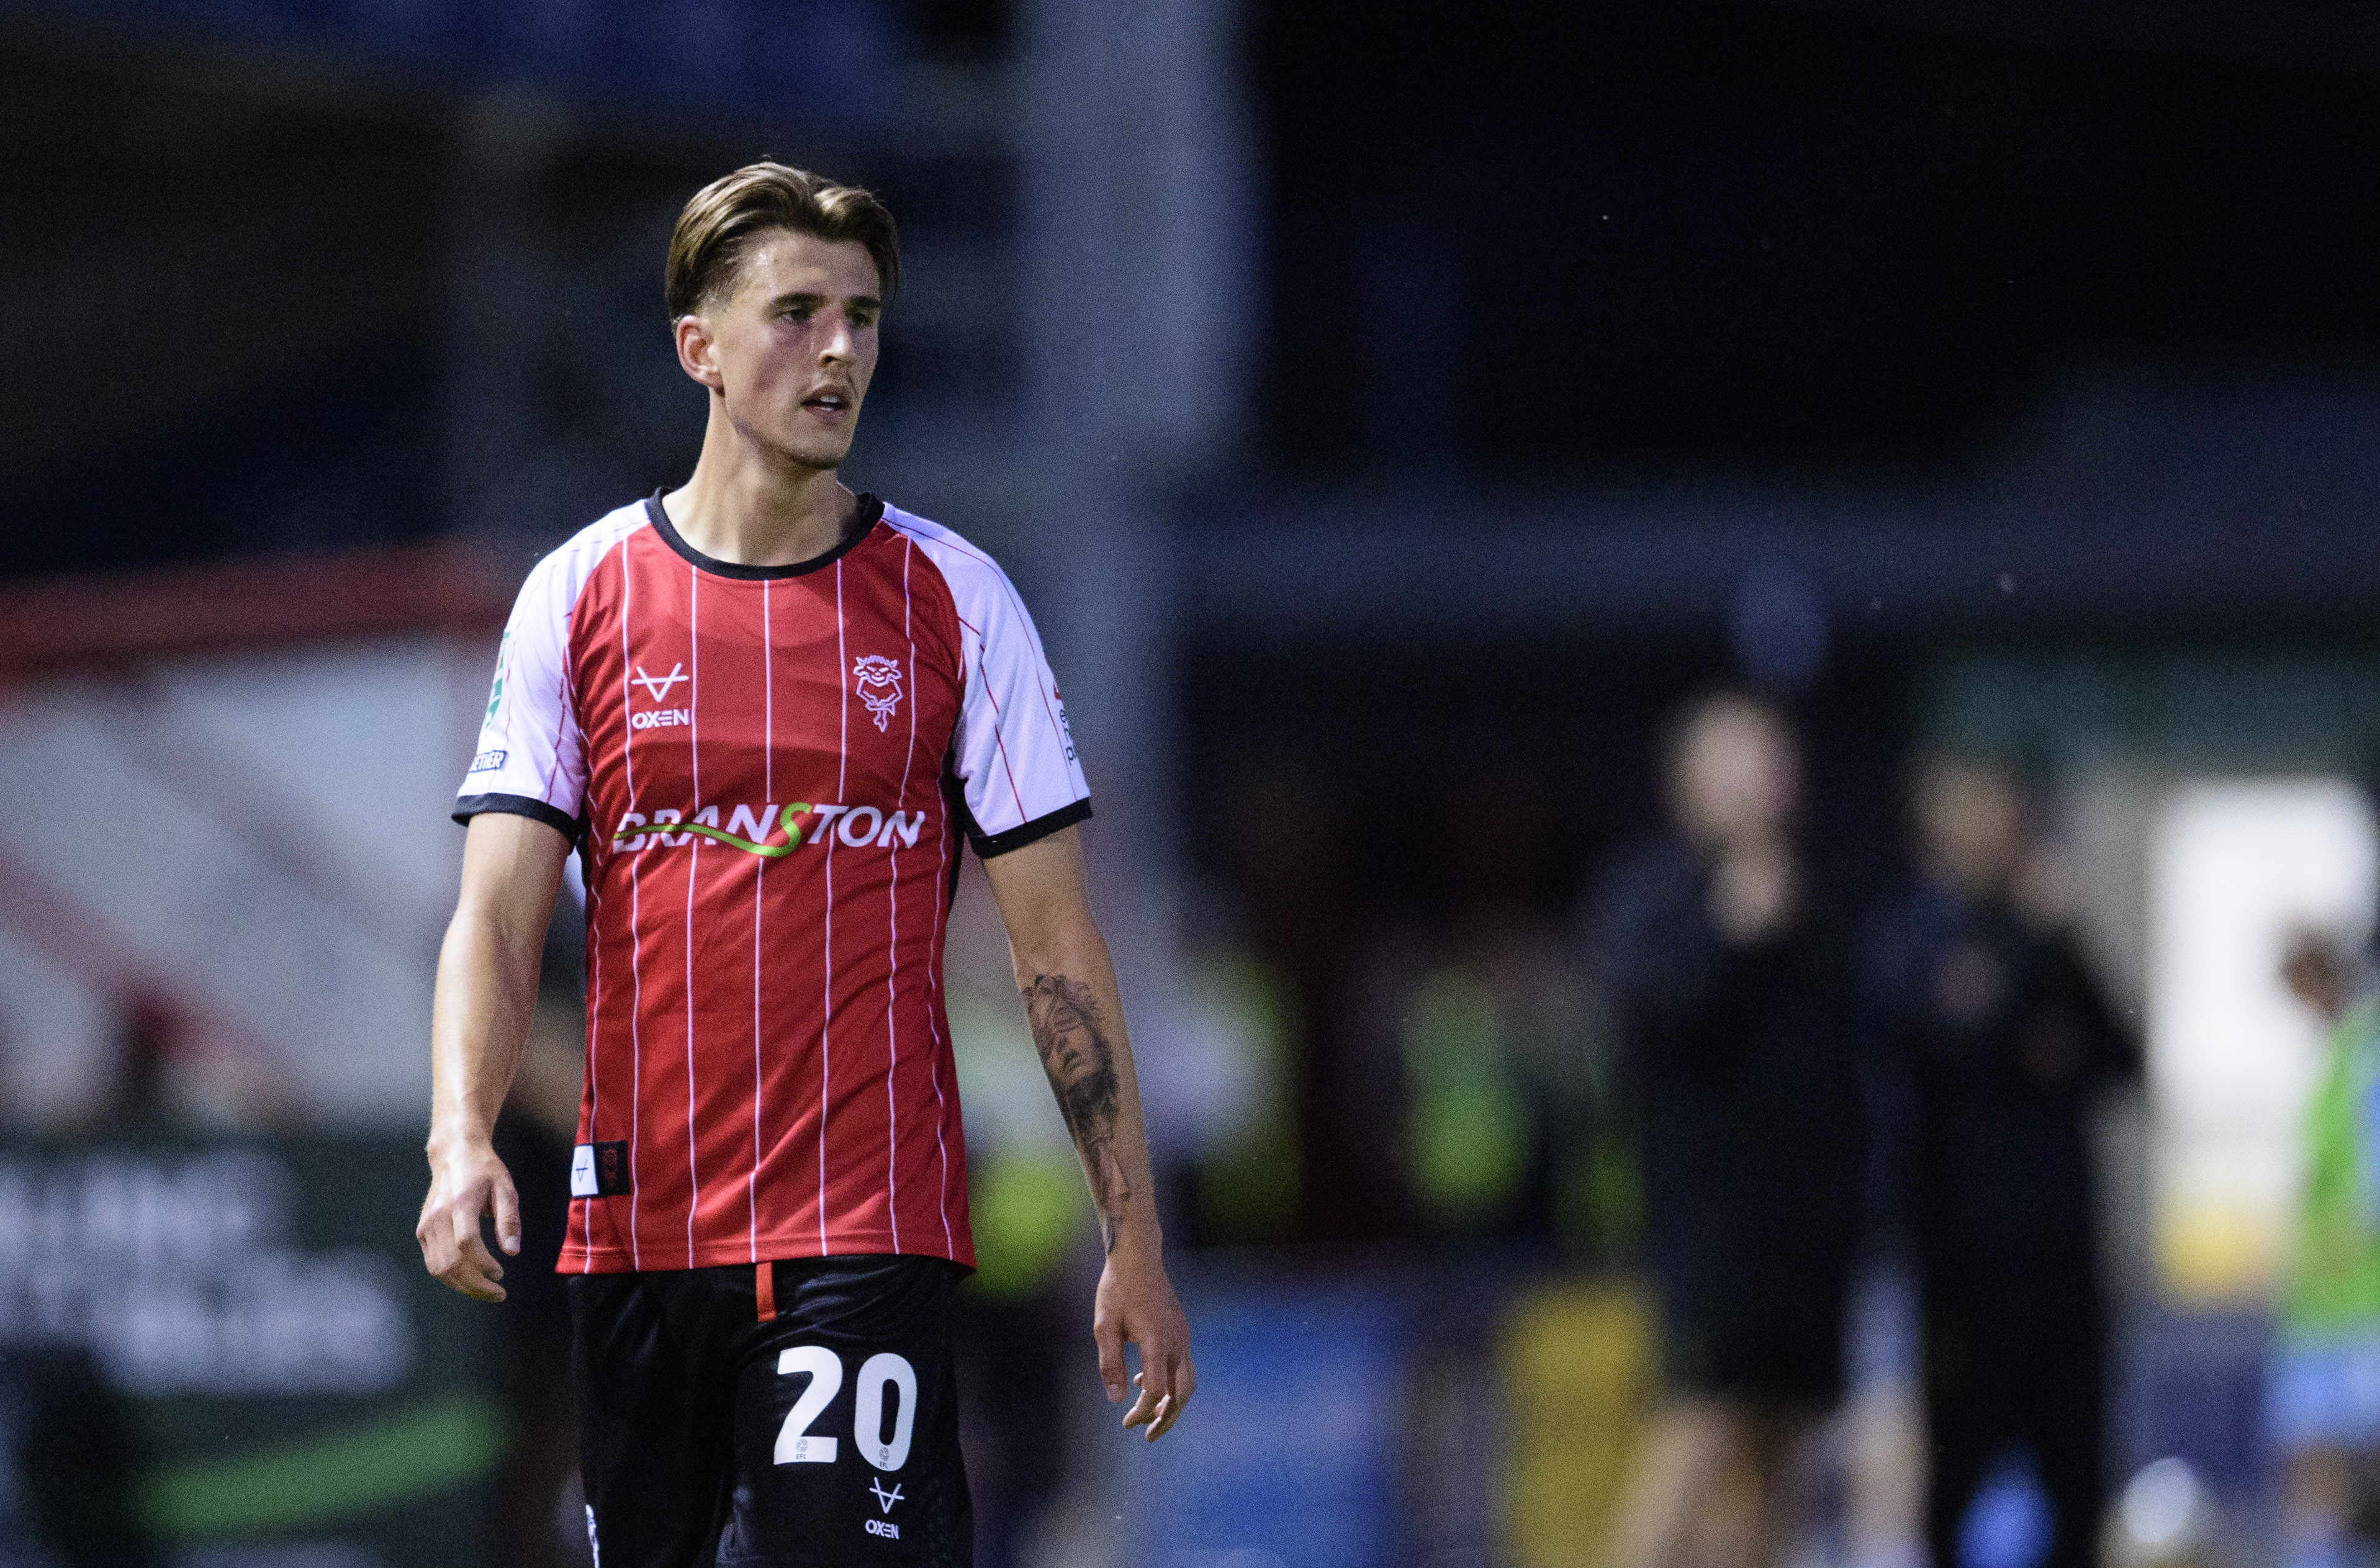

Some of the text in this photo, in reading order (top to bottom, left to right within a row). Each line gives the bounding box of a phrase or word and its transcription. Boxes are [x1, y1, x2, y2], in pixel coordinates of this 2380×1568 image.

[631, 708, 690, 729] OXEN
[610, 802, 926, 857] BRANSTON
[773, 1345, 917, 1472] 20
[879, 1461, 888, 1469] EFL
[865, 1519, 899, 1539] OXEN
